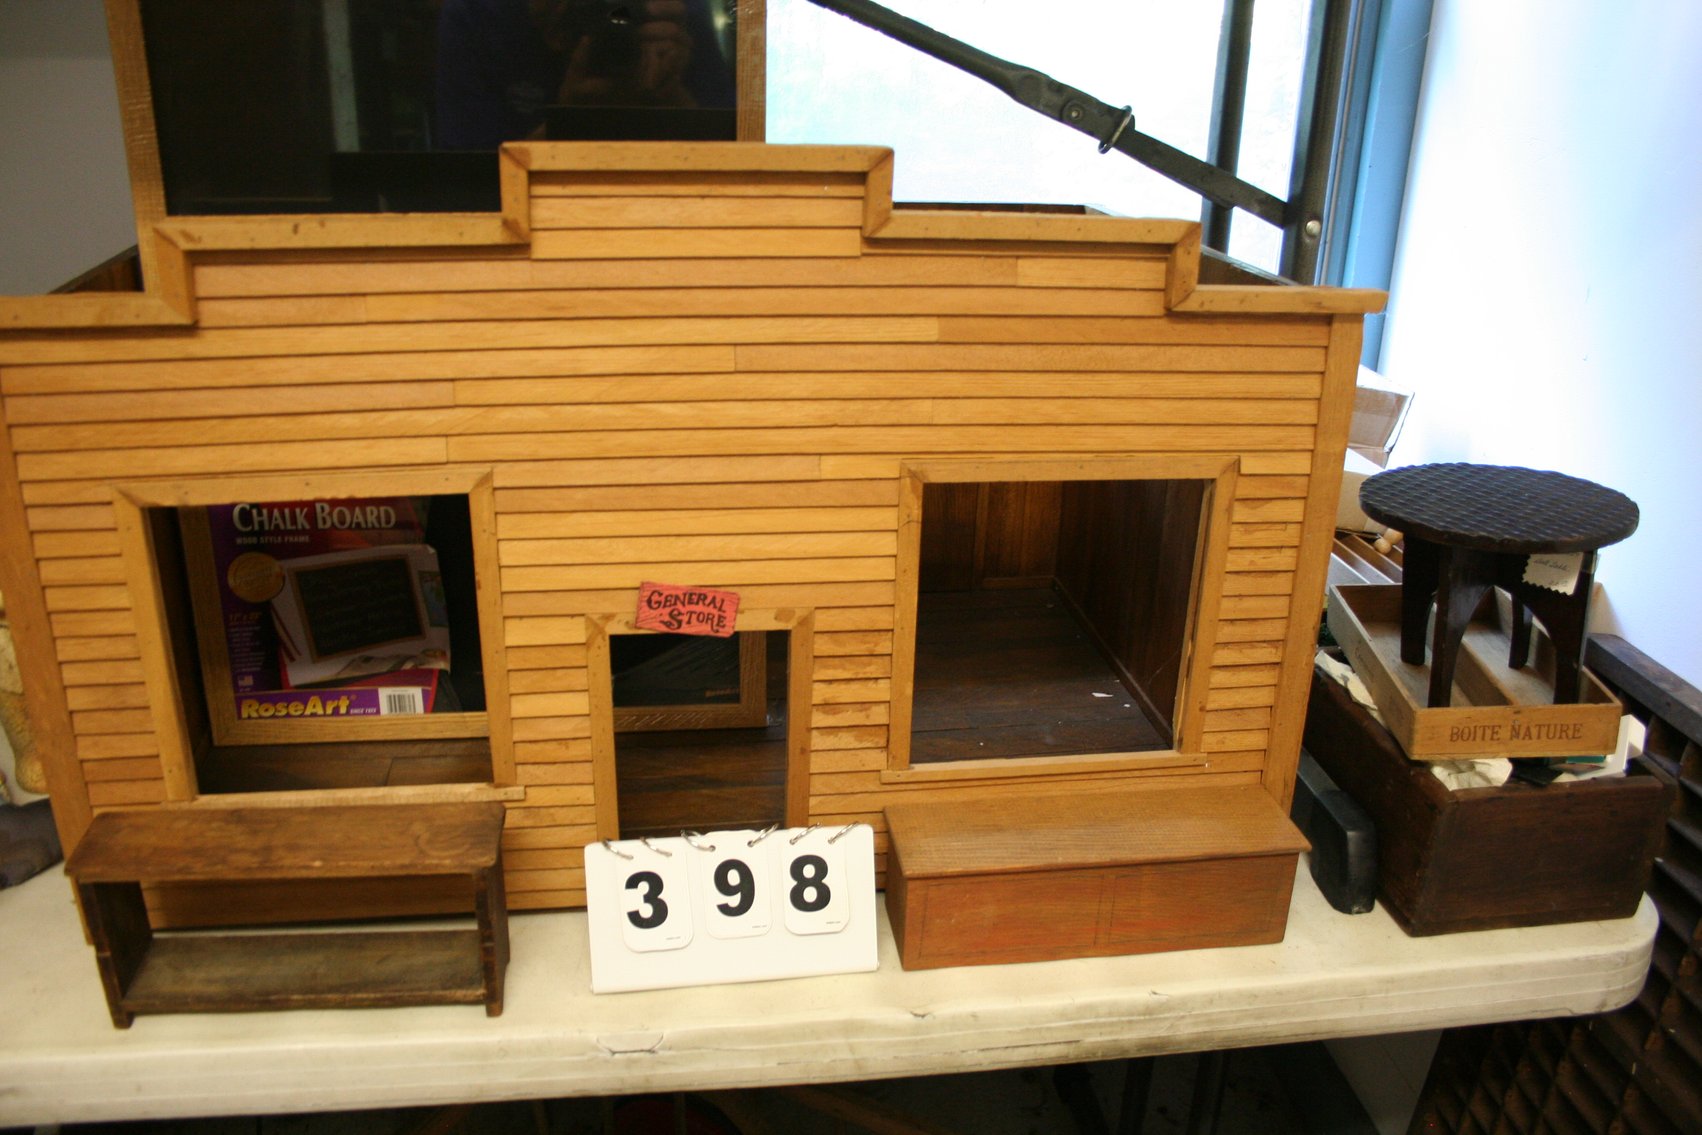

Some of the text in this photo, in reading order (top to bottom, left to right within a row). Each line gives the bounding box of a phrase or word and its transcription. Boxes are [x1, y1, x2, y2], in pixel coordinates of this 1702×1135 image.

[232, 502, 396, 532] CHALK BOARD
[646, 589, 727, 613] GENERAL
[659, 608, 727, 633] STORE
[241, 695, 350, 720] RoseArt
[1449, 723, 1583, 742] BOITE NATURE
